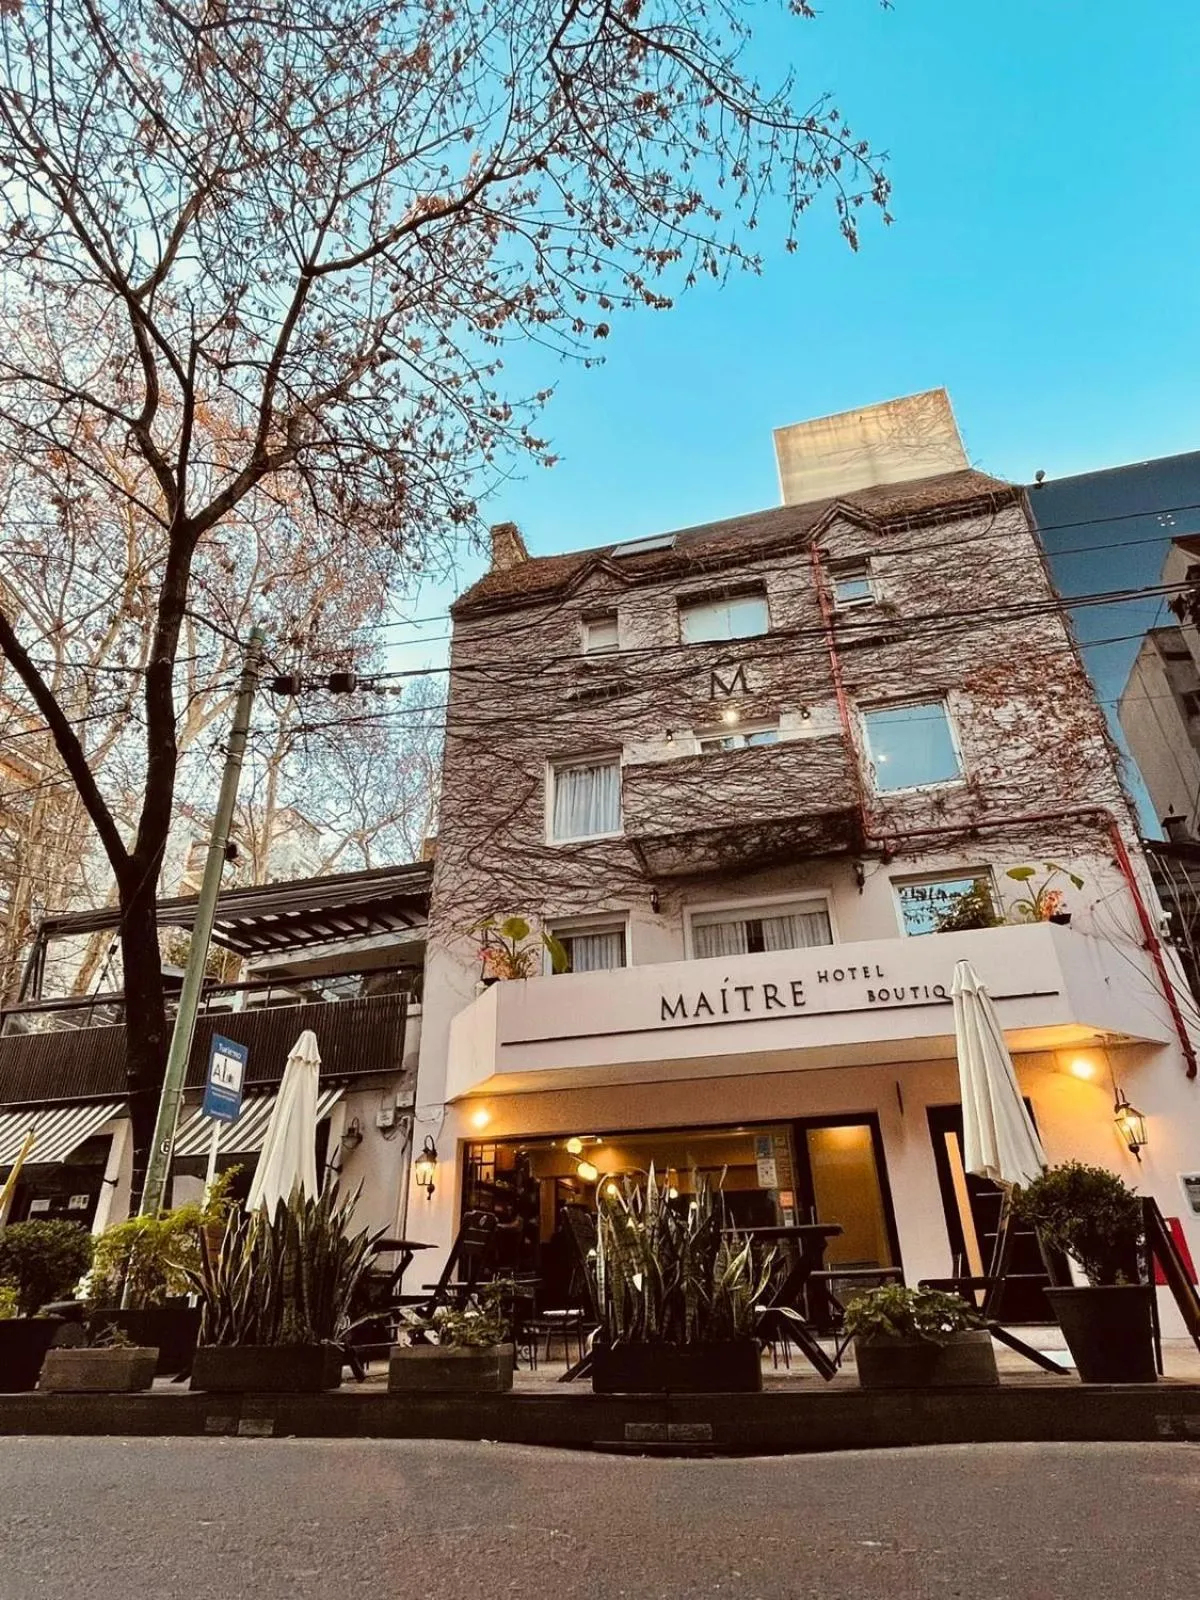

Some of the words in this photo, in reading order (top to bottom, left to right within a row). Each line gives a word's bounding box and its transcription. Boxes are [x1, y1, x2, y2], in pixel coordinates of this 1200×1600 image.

[709, 664, 753, 700] M
[817, 965, 884, 983] HOTEL
[661, 977, 806, 1021] MAÍTRE
[867, 985, 954, 1003] BOUTIQ
